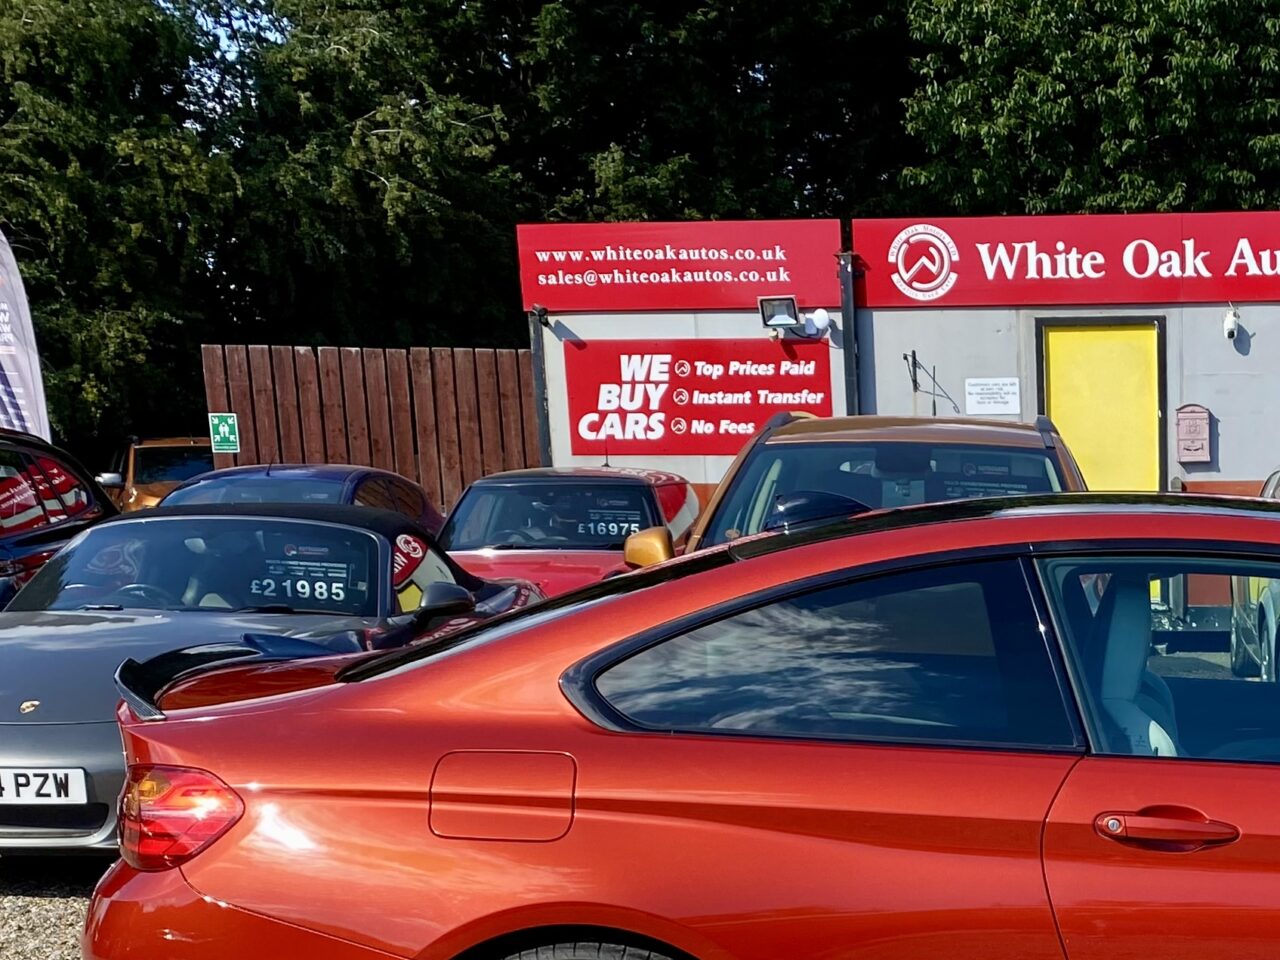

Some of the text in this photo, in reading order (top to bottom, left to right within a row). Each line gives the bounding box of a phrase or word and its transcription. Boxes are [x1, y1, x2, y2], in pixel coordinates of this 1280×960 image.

[535, 244, 787, 262] www.whiteoakautos.co.uk
[975, 240, 1106, 280] White
[1122, 238, 1213, 280] Oak
[537, 266, 791, 287] sales@whiteoakautos.co.uk
[619, 354, 672, 382] WE
[693, 360, 816, 379] Top Prices Paid
[597, 383, 669, 411] BUY
[691, 389, 824, 405] Instant Transfer
[577, 412, 666, 440] CARS
[690, 419, 755, 434] No Fees
[577, 522, 640, 536] £16975
[250, 578, 345, 601] £21985
[13, 773, 69, 798] PZW
